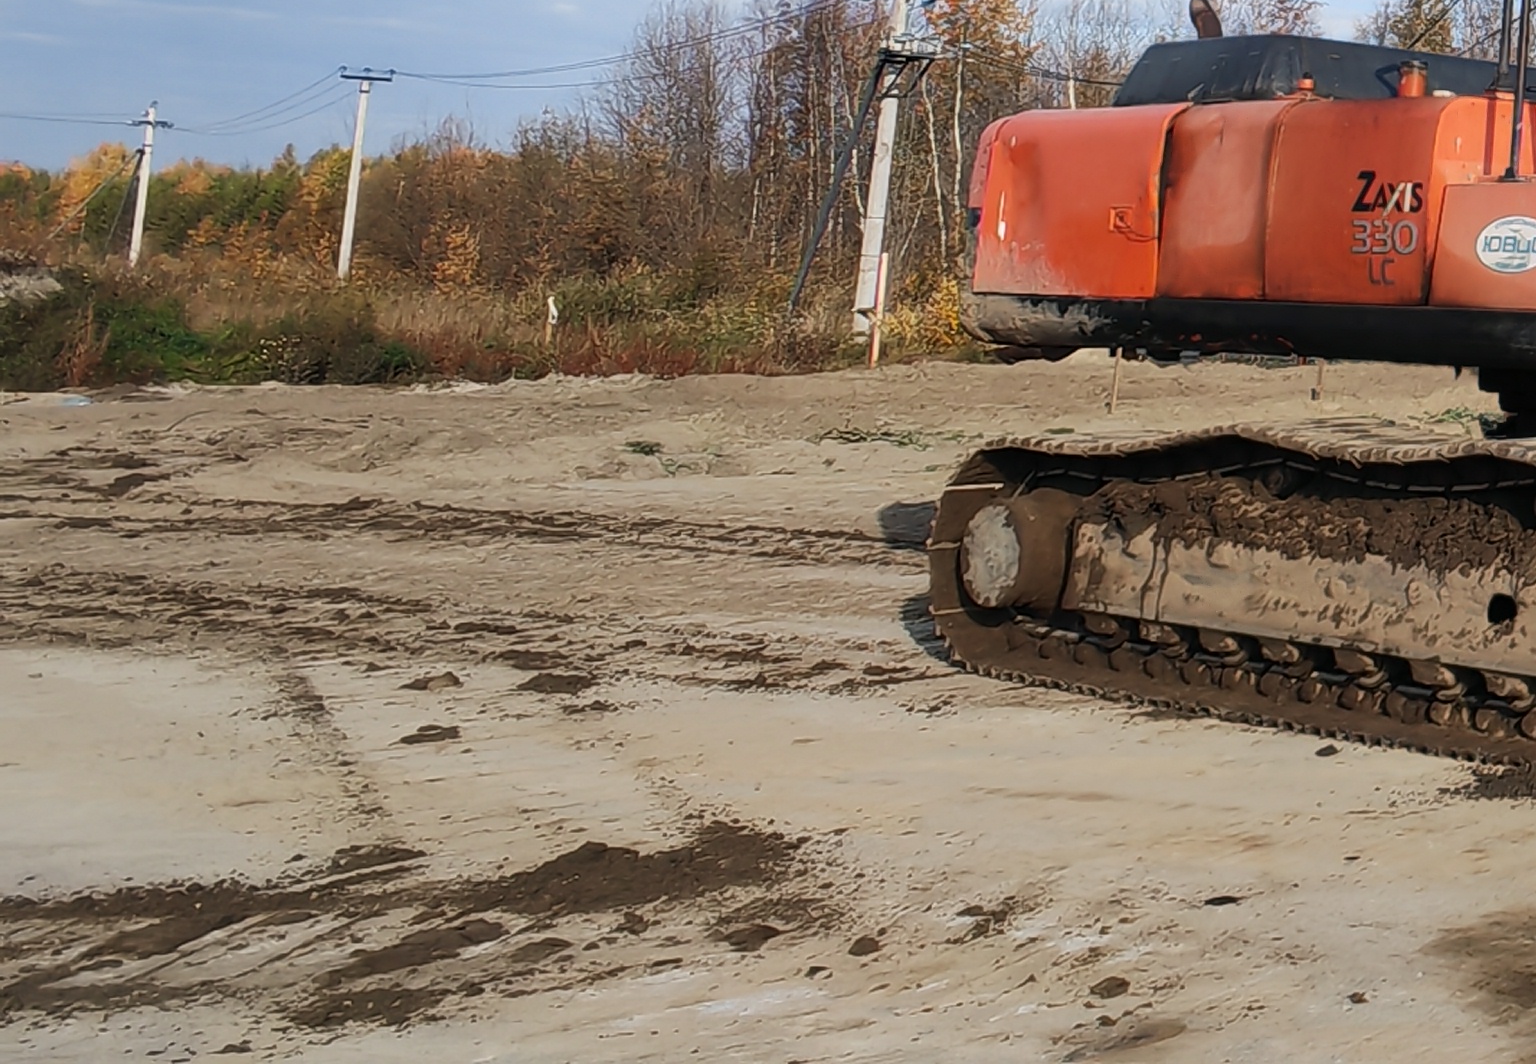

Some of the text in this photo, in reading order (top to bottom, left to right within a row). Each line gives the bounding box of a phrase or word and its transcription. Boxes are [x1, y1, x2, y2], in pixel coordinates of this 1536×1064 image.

[1351, 170, 1423, 217] ZAXIS
[1351, 219, 1418, 255] 330
[1368, 257, 1395, 285] LC
